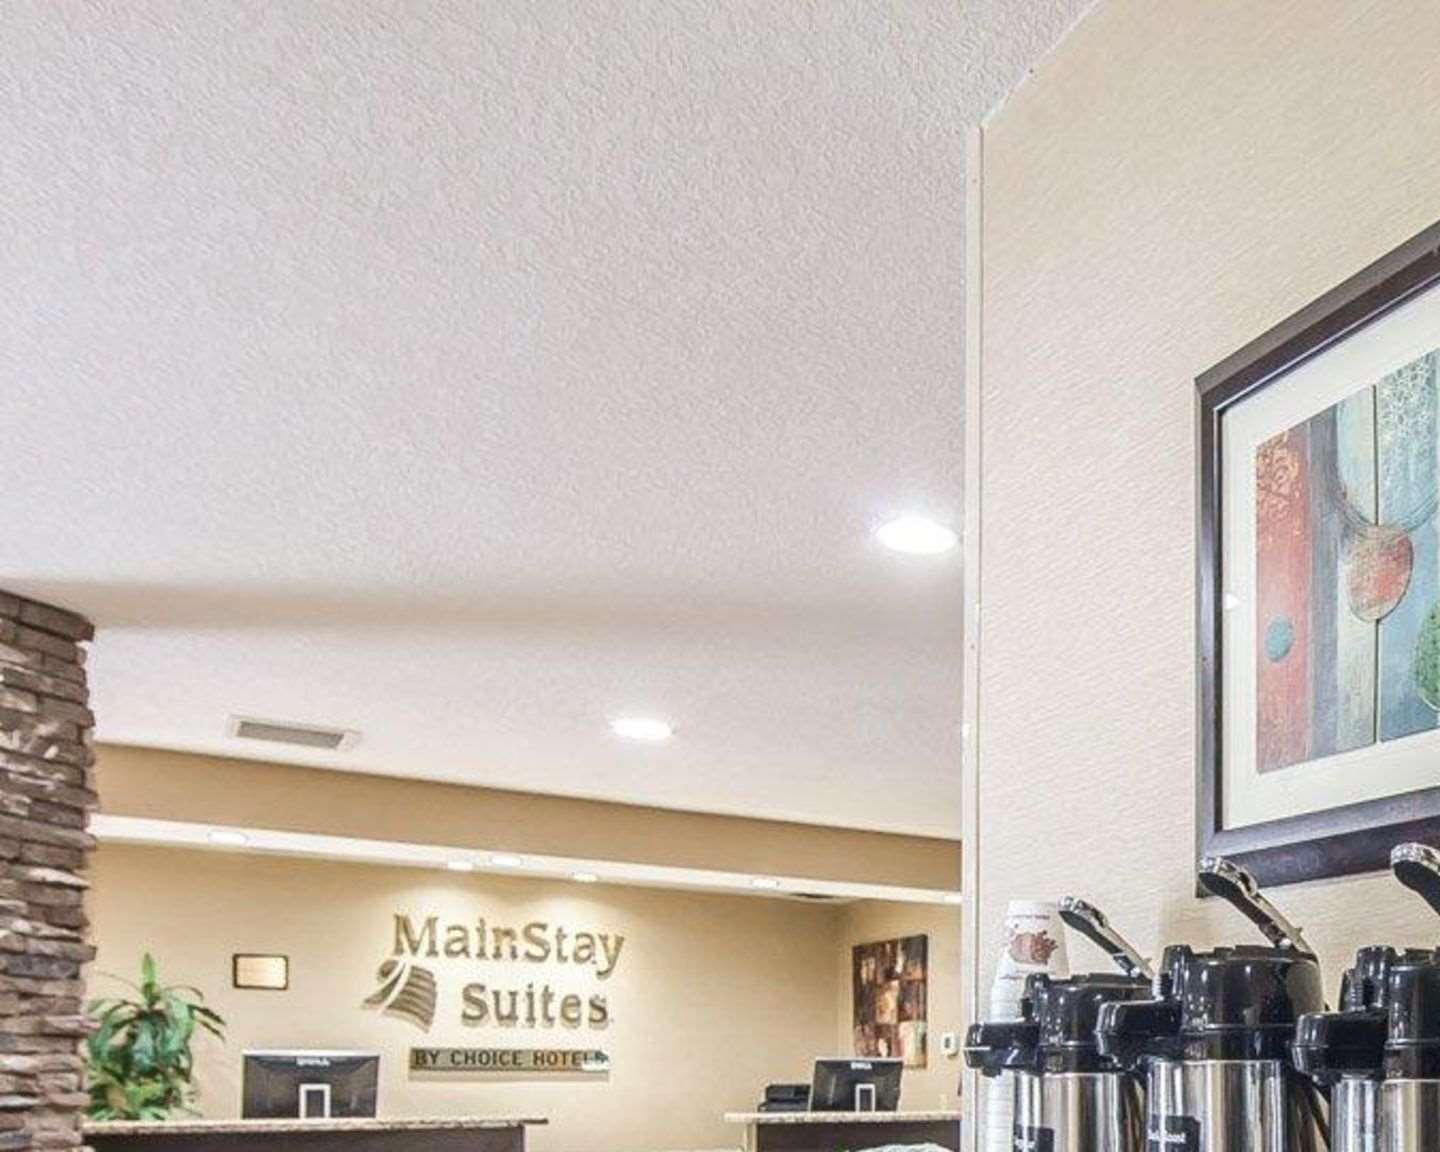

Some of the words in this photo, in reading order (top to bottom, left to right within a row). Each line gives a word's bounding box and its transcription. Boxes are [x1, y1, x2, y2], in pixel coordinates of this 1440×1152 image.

[393, 913, 626, 979] MainStay
[461, 983, 608, 1025] Suites
[415, 1050, 439, 1066] BY
[450, 1050, 523, 1066] CHOICE
